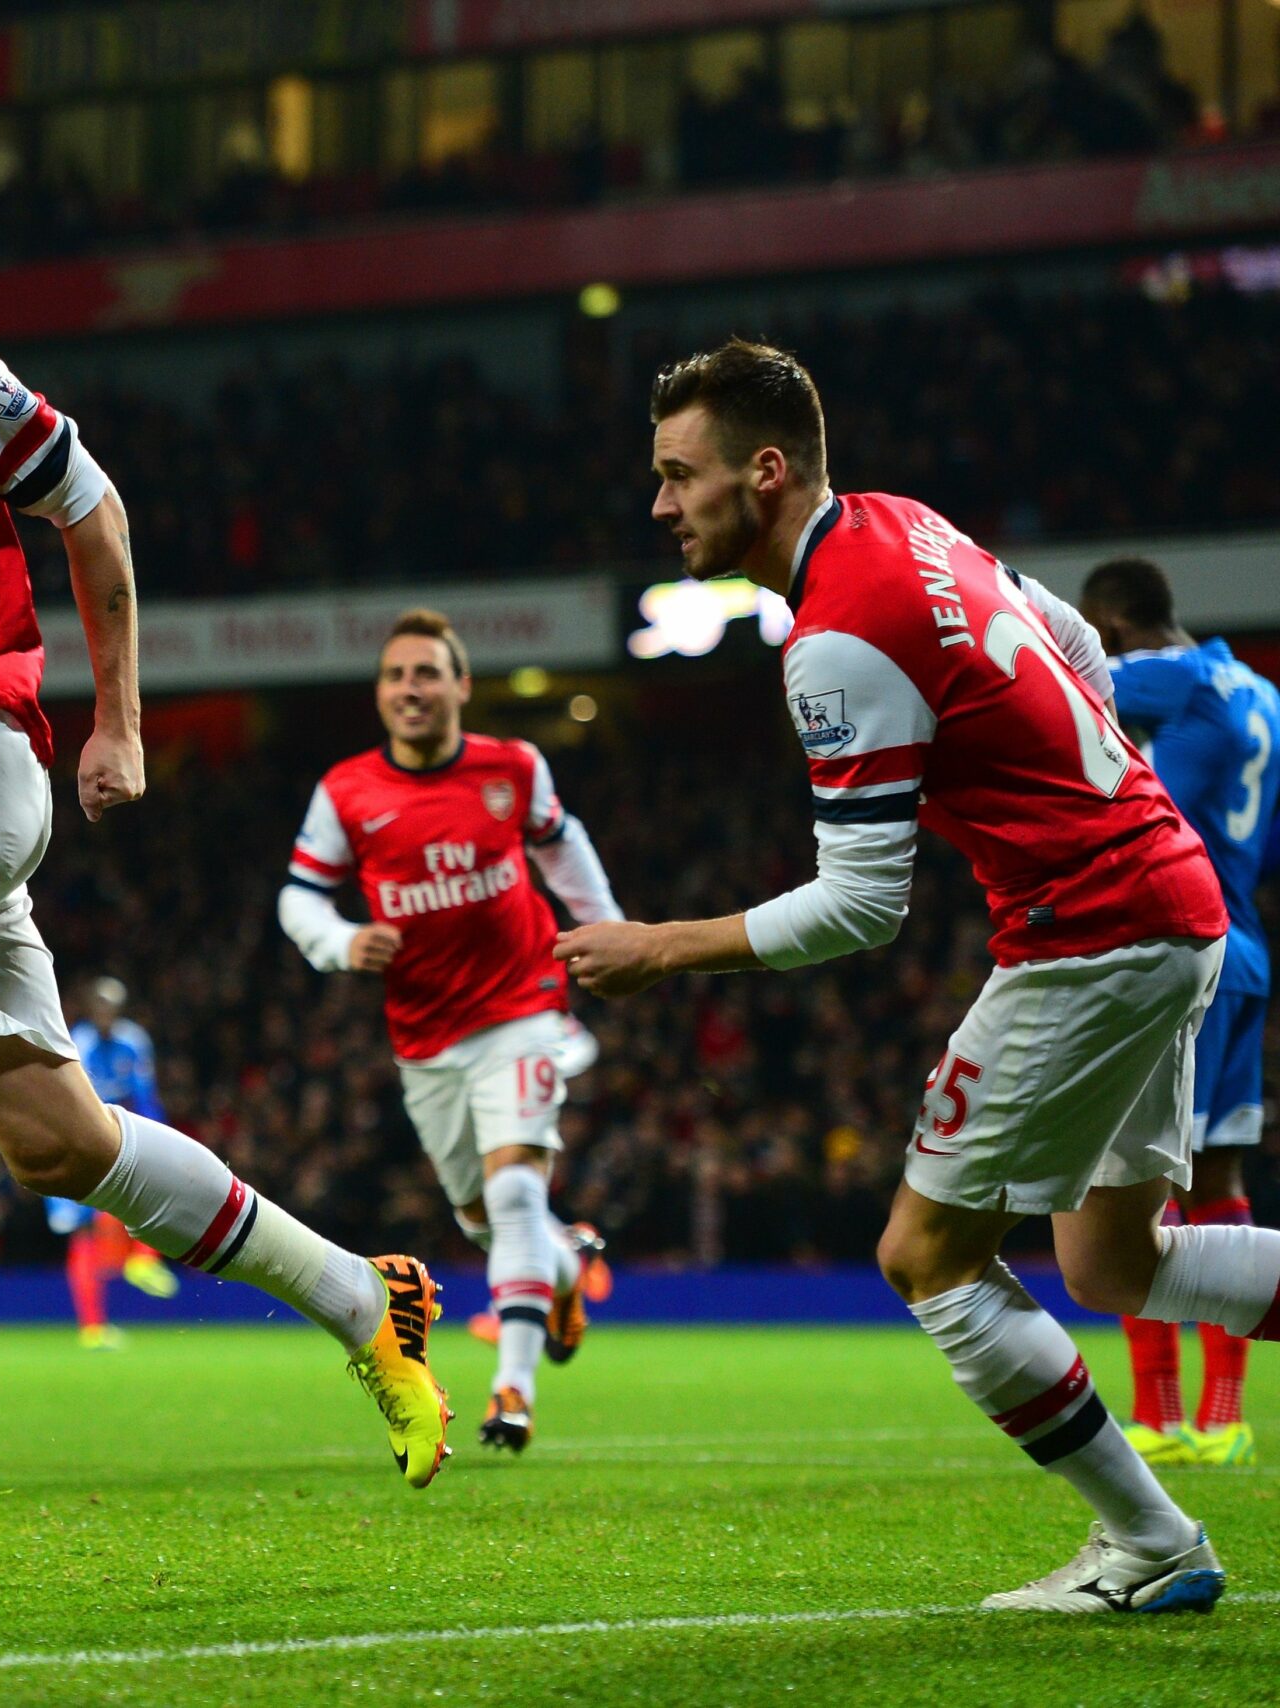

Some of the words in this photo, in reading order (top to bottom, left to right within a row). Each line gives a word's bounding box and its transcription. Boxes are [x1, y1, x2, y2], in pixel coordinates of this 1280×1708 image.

[984, 562, 1131, 799] 2
[1227, 709, 1272, 843] 3
[423, 838, 477, 874] Fly
[515, 1056, 556, 1105] 19
[372, 1260, 427, 1367] NIKE
